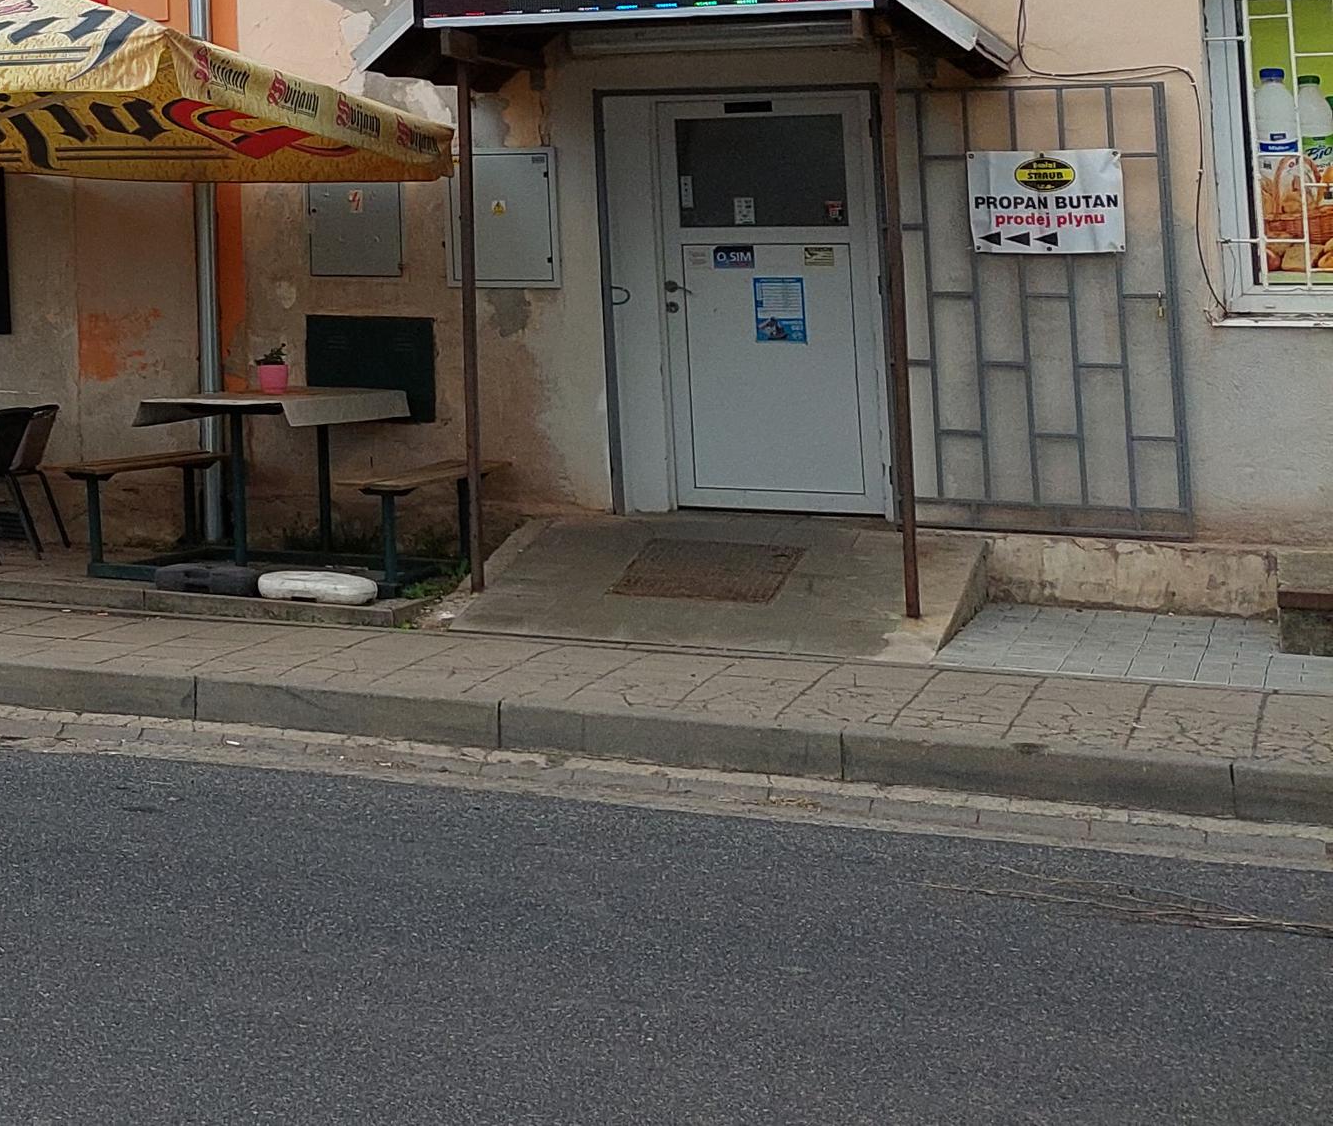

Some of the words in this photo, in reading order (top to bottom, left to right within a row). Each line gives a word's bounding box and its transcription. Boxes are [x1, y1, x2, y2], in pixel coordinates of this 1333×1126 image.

[267, 69, 321, 119] Svijany
[336, 92, 381, 139] Svijany
[974, 196, 1048, 210] PROPAN
[1055, 194, 1118, 209] BUTAN
[995, 213, 1051, 228] prodej
[1056, 212, 1105, 228] plynu
[730, 251, 752, 262] SIM
